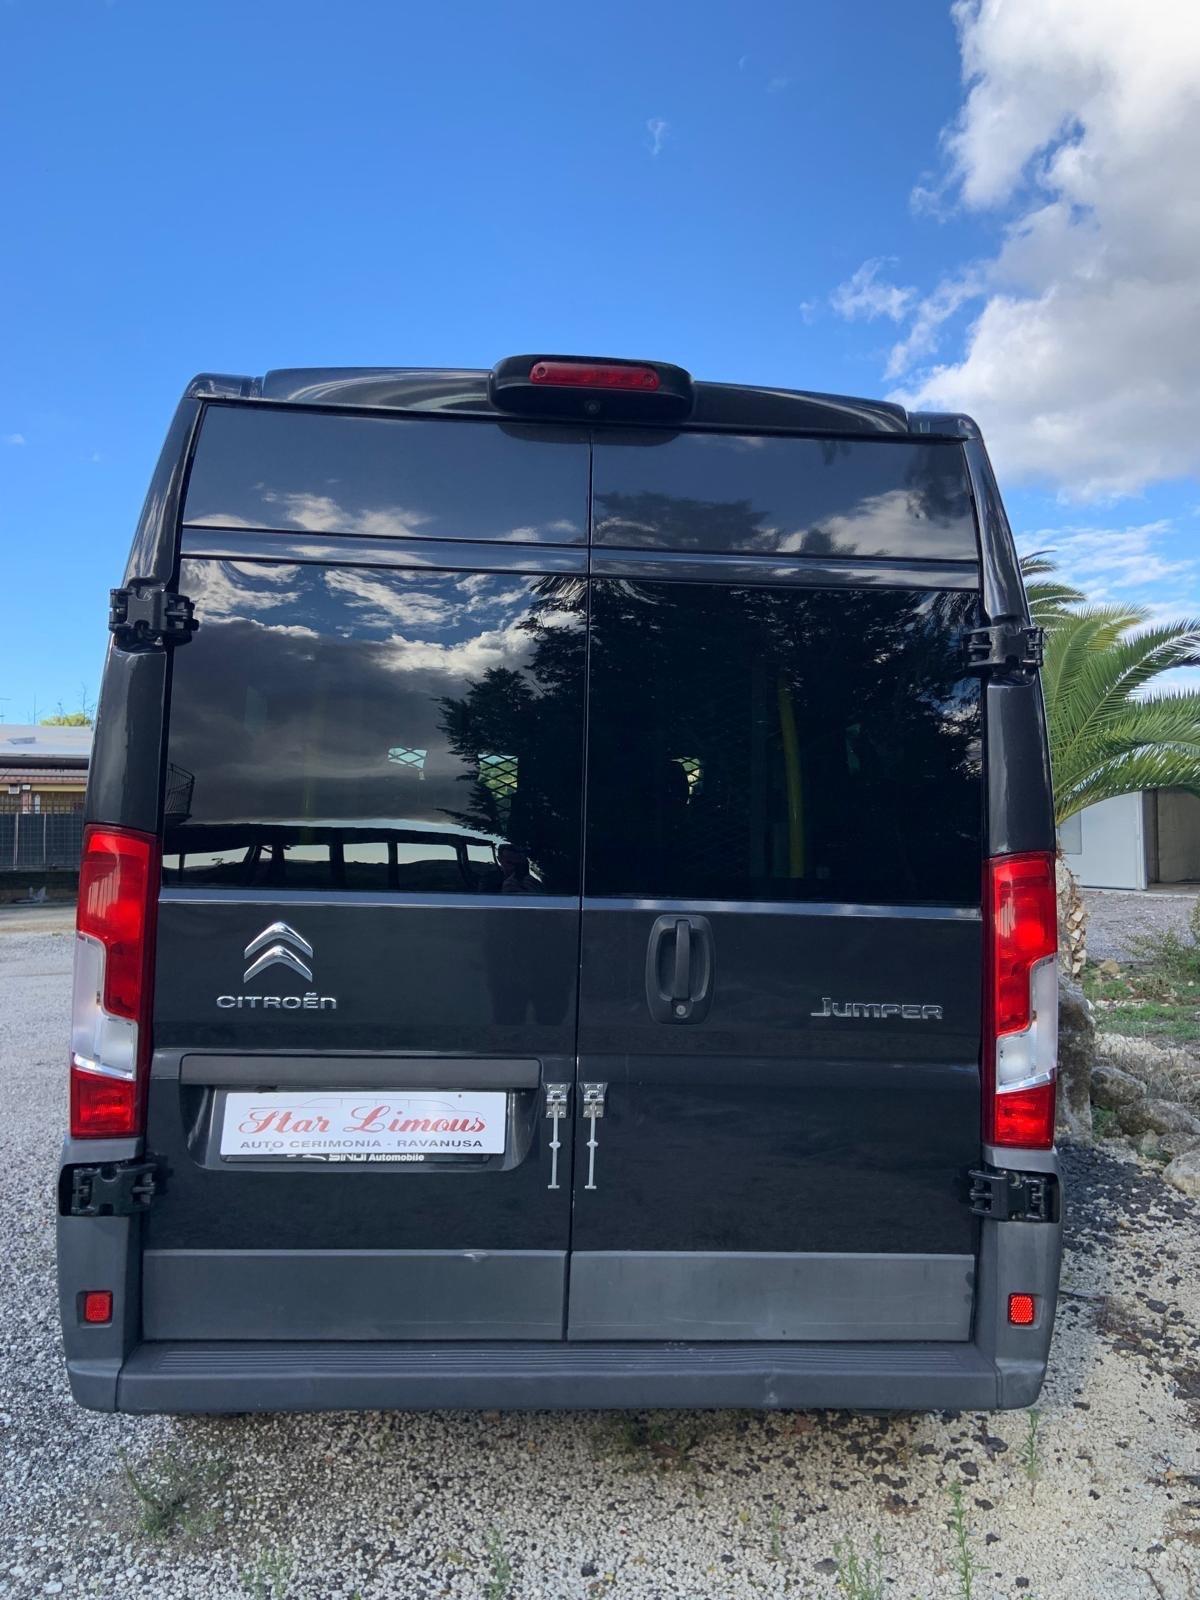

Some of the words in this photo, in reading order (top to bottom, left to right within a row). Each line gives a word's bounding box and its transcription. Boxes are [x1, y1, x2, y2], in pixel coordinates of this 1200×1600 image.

[237, 1109, 330, 1134] Star
[342, 1104, 487, 1134] Limous
[240, 1140, 284, 1149] AUTO
[288, 1139, 382, 1149] CERIMONIA
[396, 1139, 483, 1148] RAVANUSA
[368, 1153, 425, 1162] Automobile
